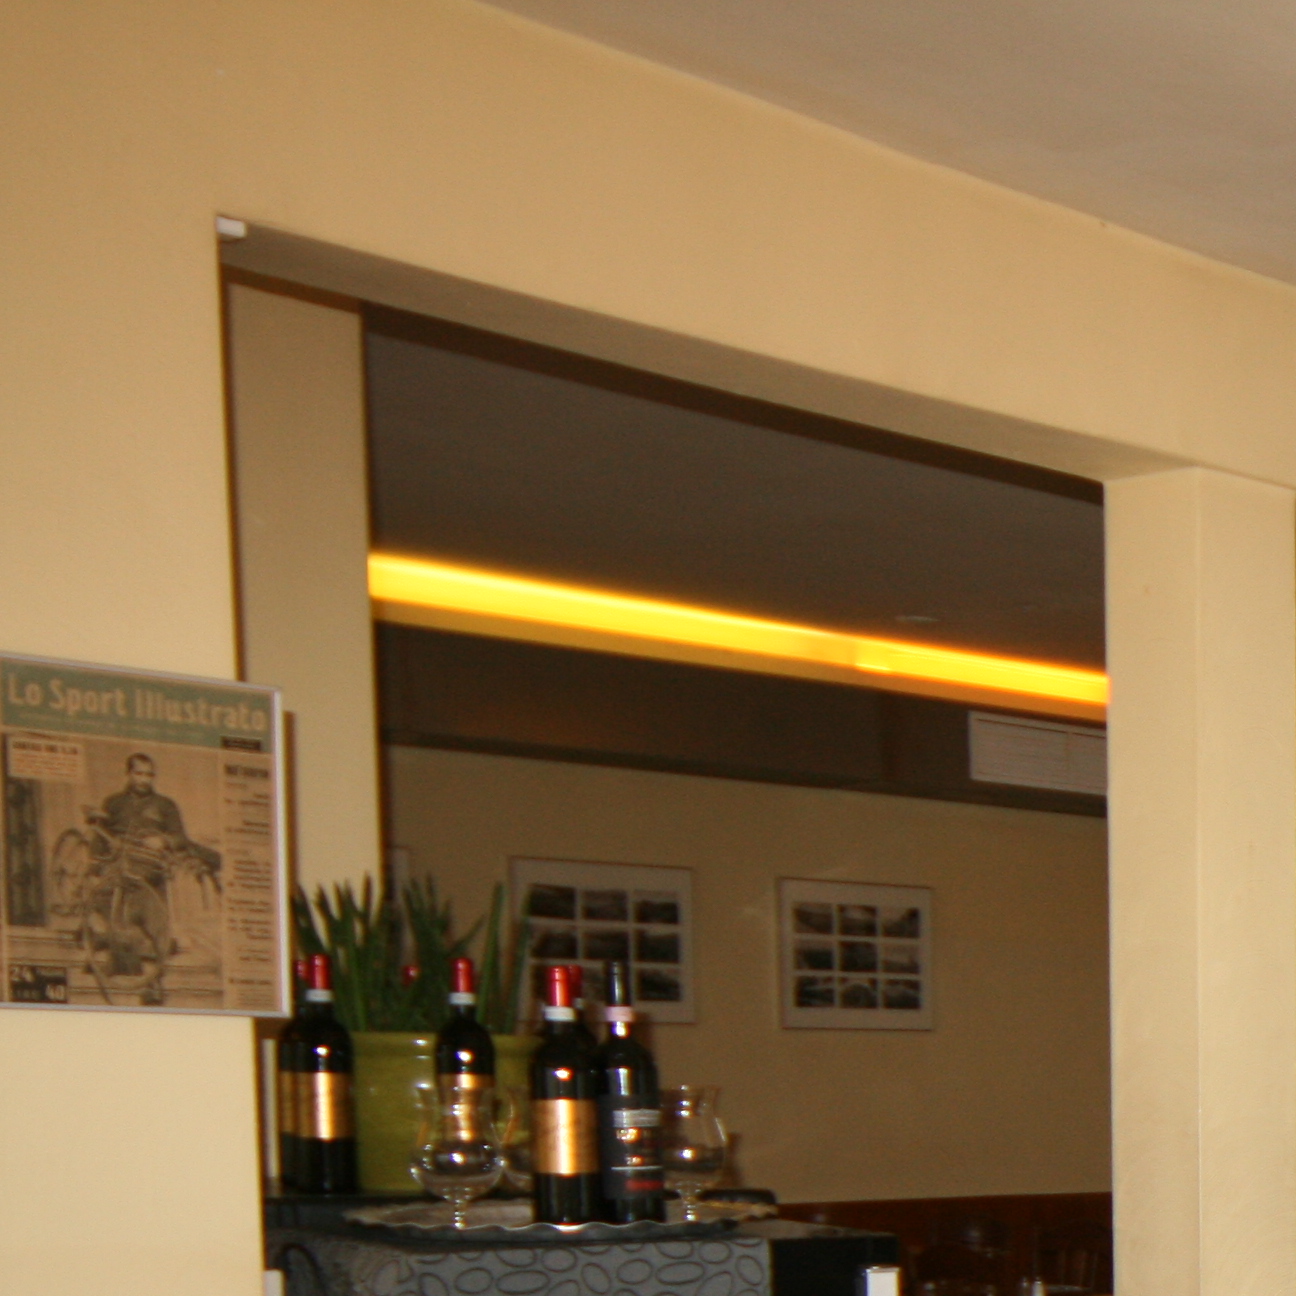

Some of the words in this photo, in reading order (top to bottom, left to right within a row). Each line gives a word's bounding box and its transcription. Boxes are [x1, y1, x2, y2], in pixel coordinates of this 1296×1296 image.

[8, 672, 43, 707] Lo
[48, 677, 129, 718] Sport
[135, 689, 268, 731] Illustrato
